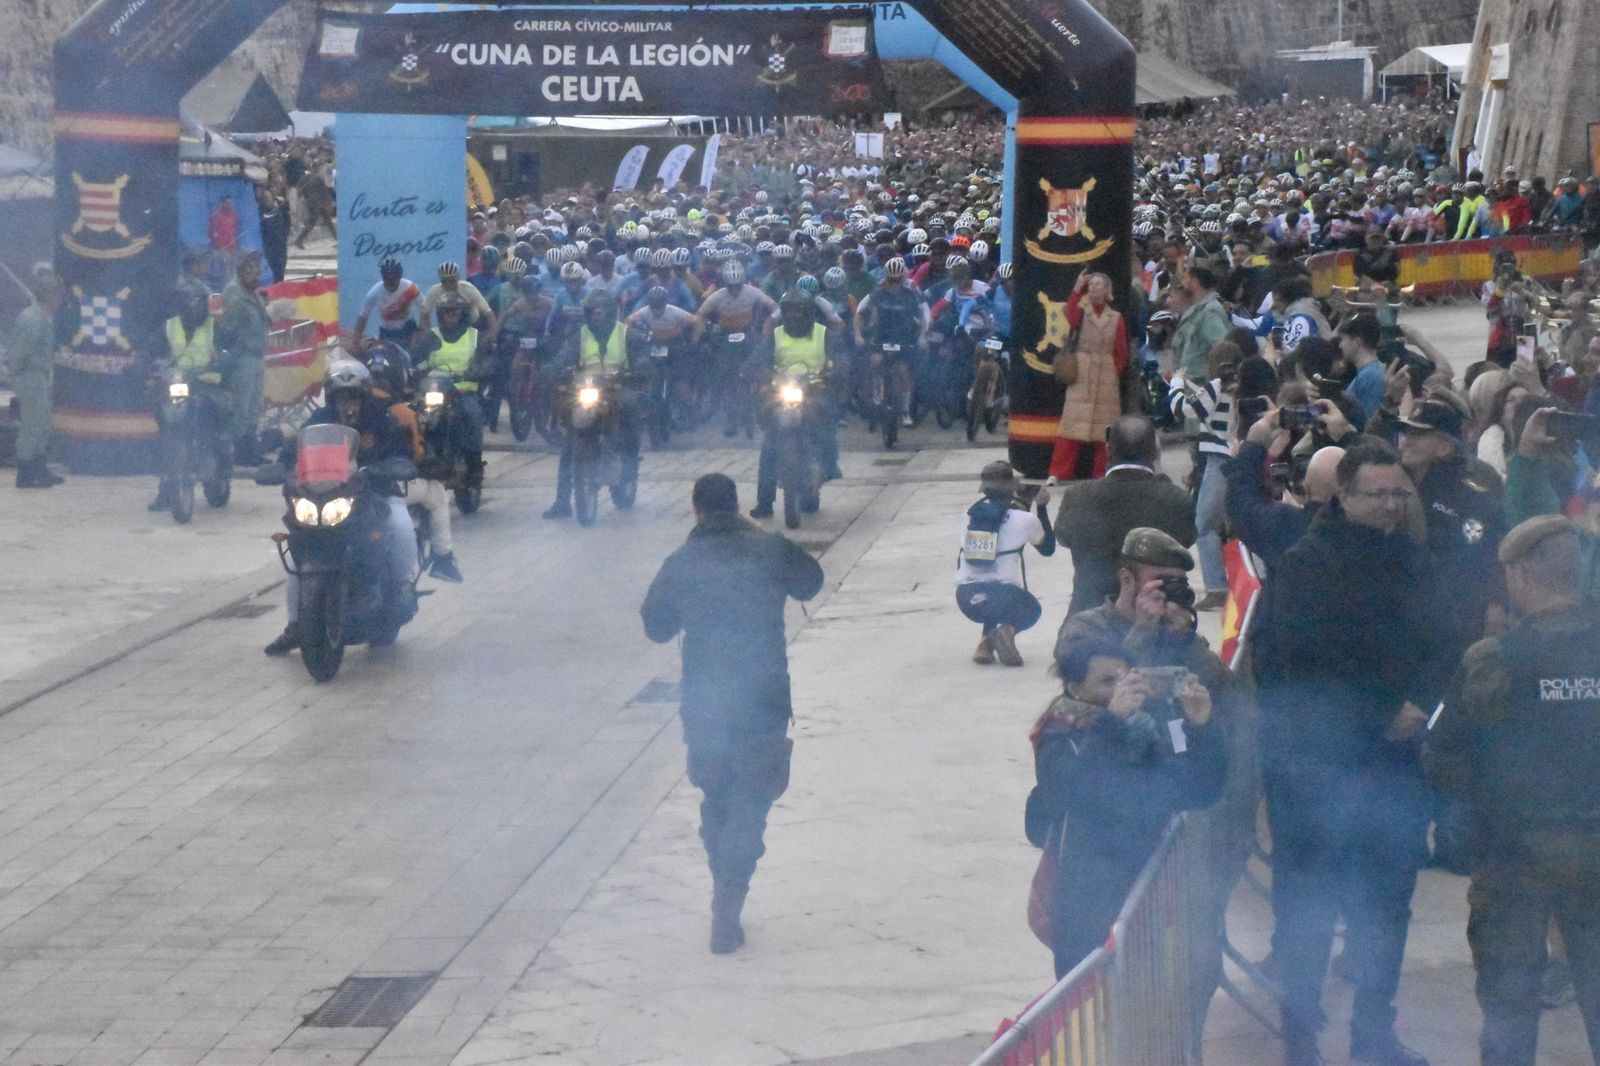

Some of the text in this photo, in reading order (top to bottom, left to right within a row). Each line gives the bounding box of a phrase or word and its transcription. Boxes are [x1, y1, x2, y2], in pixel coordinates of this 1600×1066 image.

[513, 17, 673, 32] CARRERA CÍVICO-MILITAR
[542, 45, 577, 66] DE
[586, 45, 619, 66] LA
[541, 76, 644, 102] CEUTA
[350, 192, 448, 221] Ceuta es
[353, 231, 449, 258] Deporte
